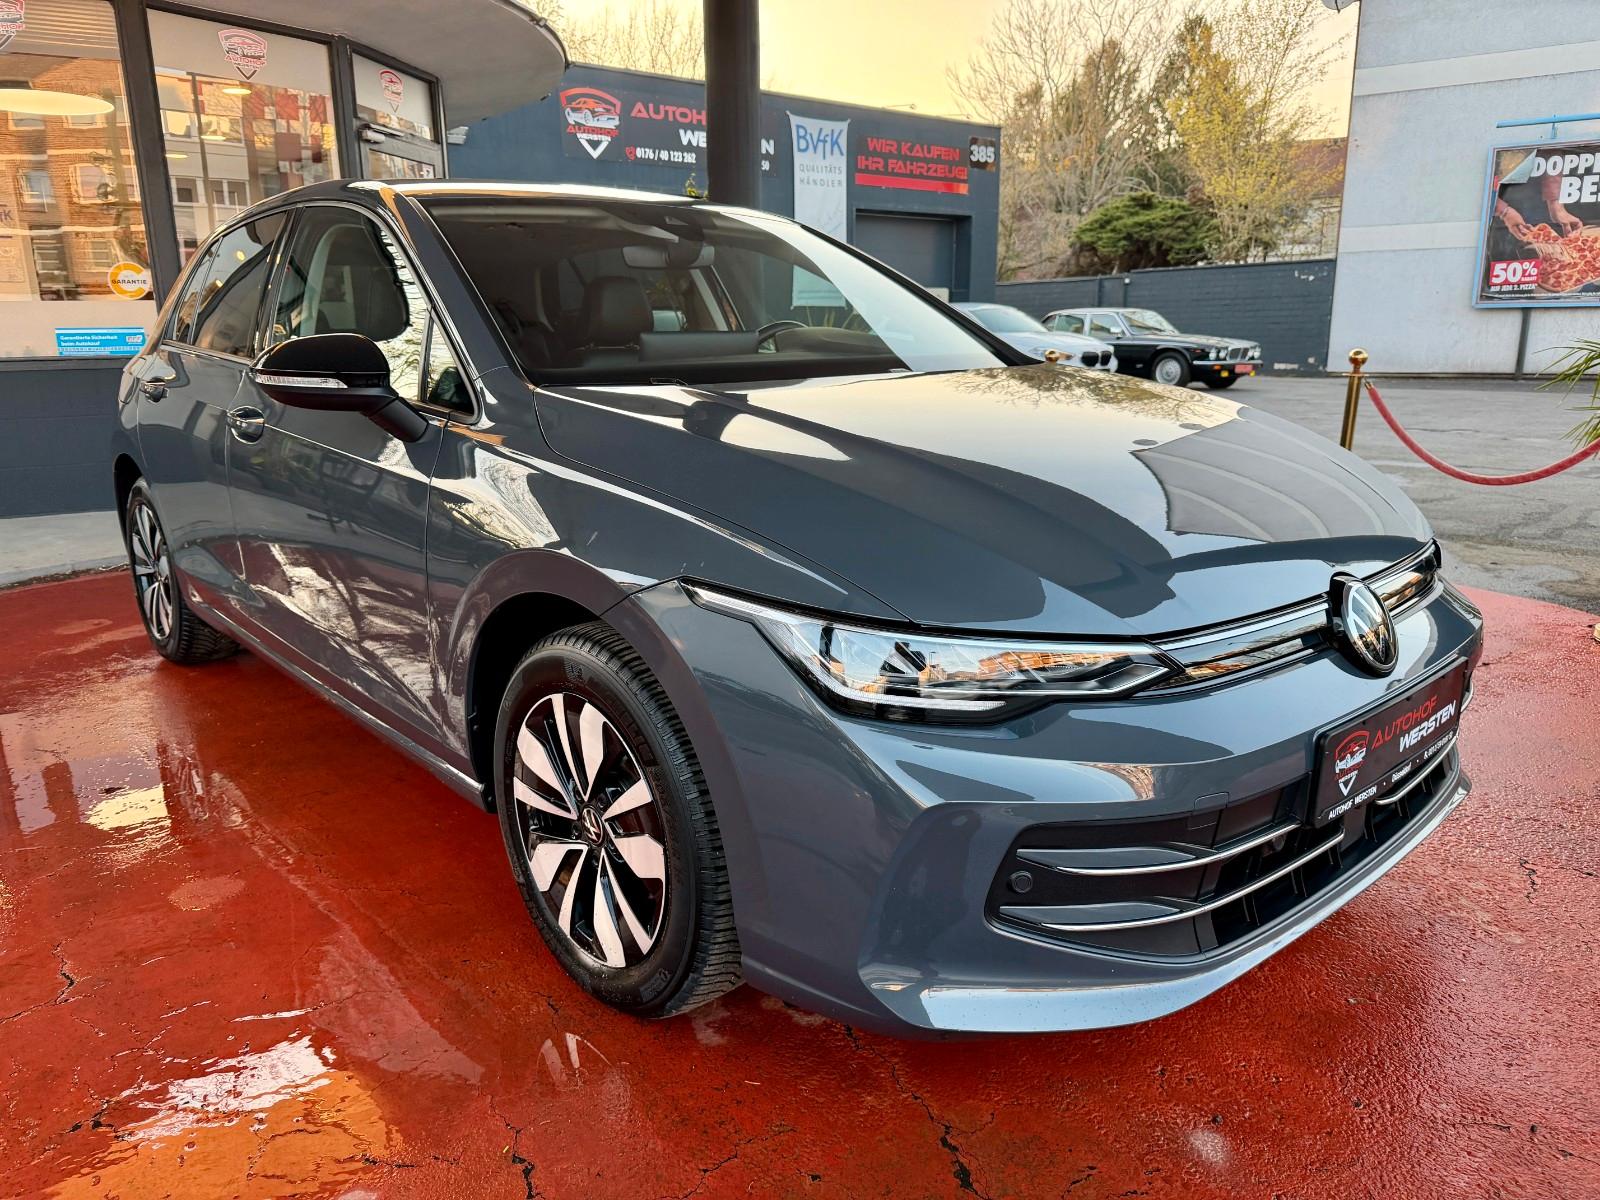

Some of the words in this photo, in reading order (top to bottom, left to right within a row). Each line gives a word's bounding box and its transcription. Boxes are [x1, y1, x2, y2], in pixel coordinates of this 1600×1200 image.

[630, 101, 707, 126] AUTOH
[566, 124, 619, 138] AUTOHOF
[795, 124, 844, 160] BVfK
[636, 147, 655, 160] 0176
[659, 150, 669, 161] 40
[670, 151, 683, 163] 123
[683, 151, 697, 164] 262
[867, 137, 898, 154] WIR
[901, 141, 960, 161] KAUFEN
[970, 144, 995, 163] 385
[856, 155, 885, 172] IHR
[1558, 174, 1600, 204] BE
[1491, 261, 1538, 284] 50%
[1371, 695, 1438, 750] AUTOHOF
[1399, 699, 1457, 753] WERSTEN
[1328, 799, 1354, 820] AUTOHOF
[1354, 785, 1378, 805] WERSTEN
